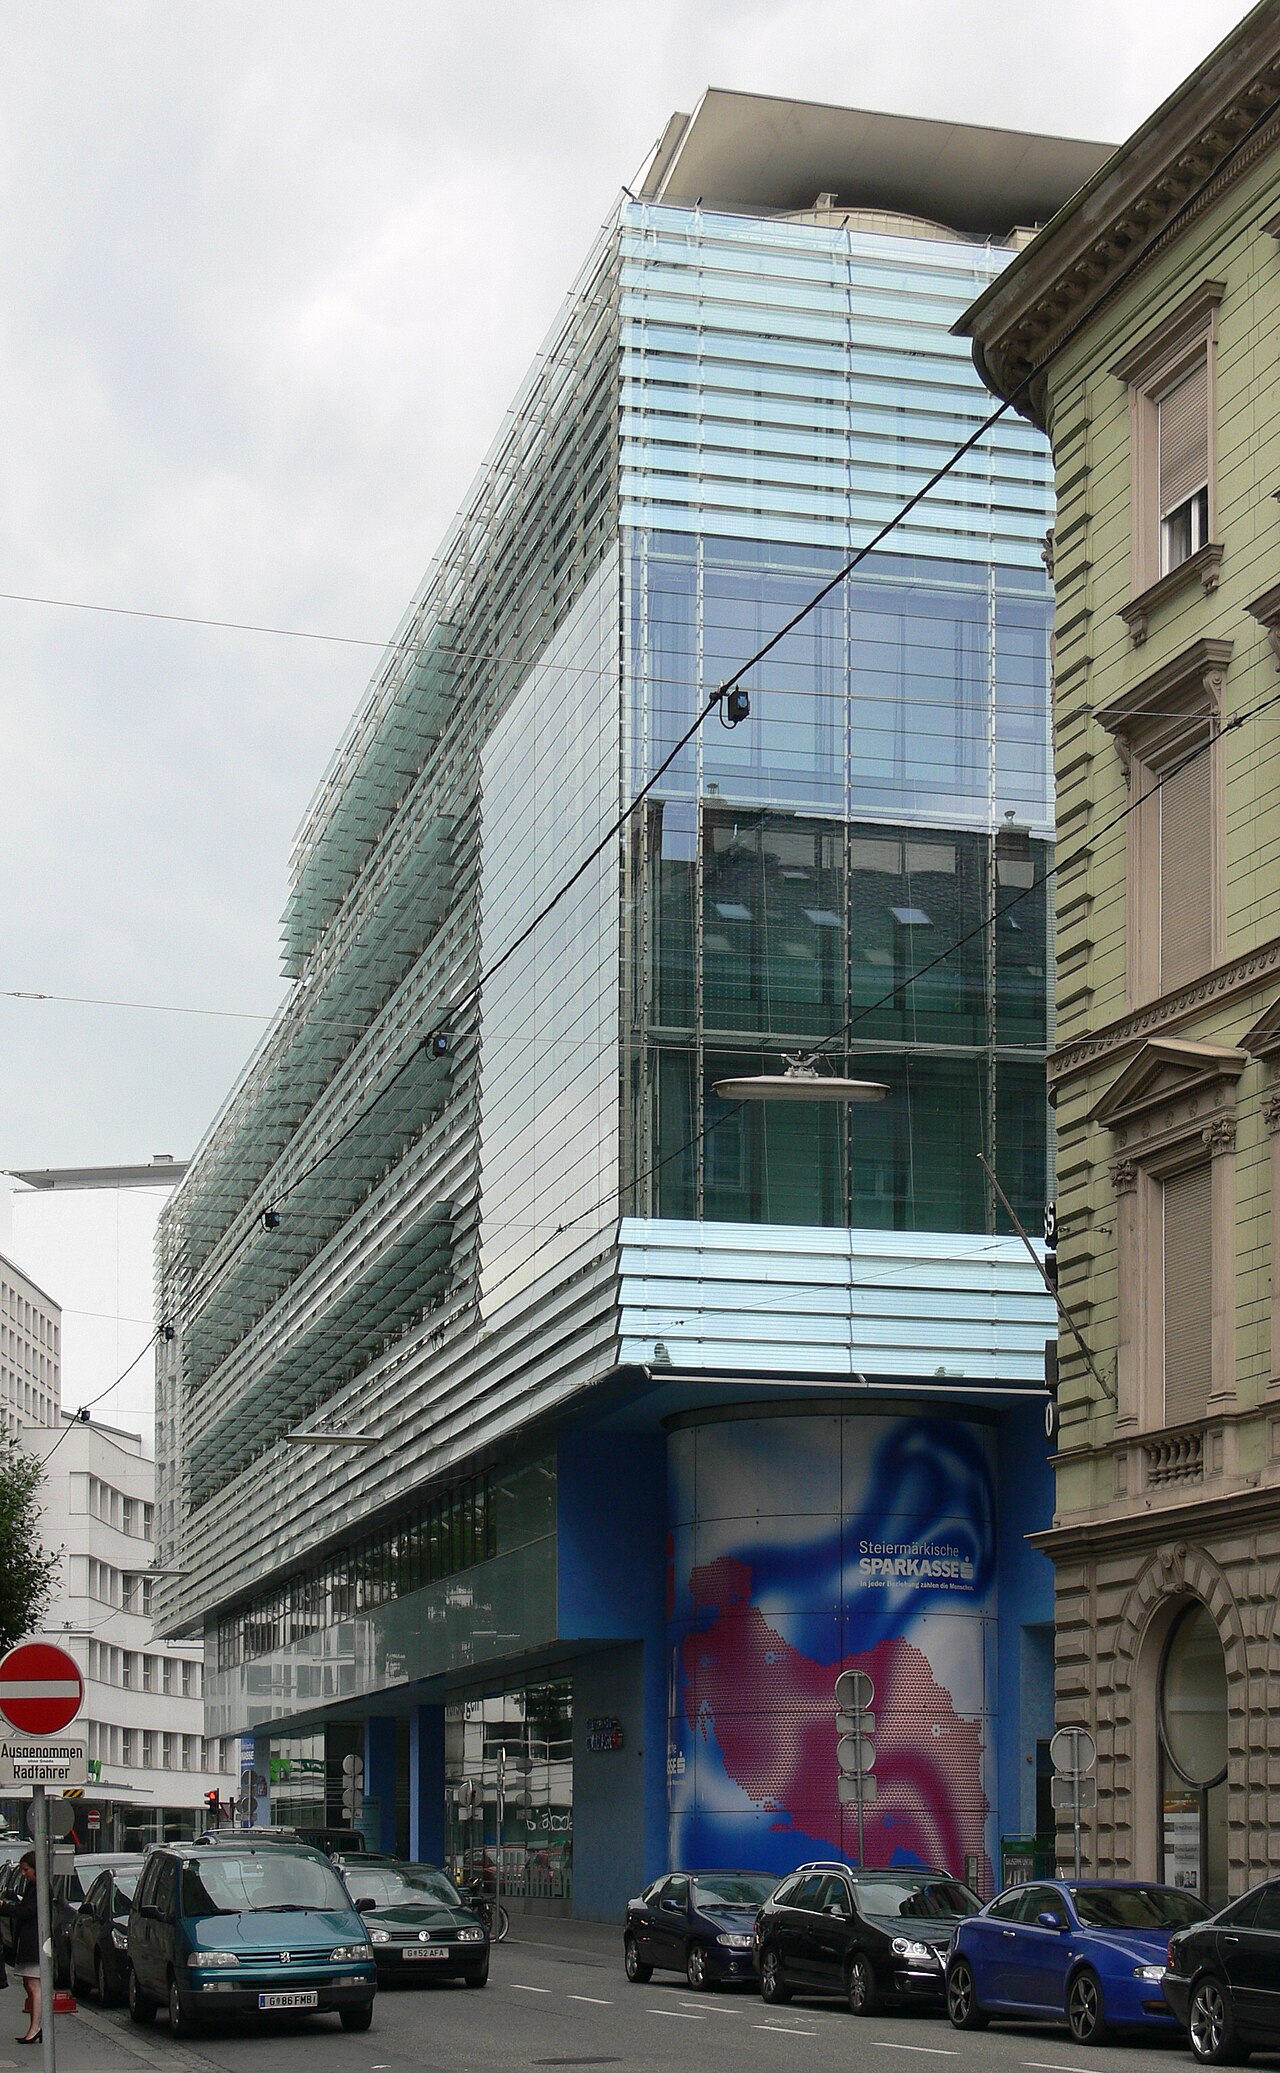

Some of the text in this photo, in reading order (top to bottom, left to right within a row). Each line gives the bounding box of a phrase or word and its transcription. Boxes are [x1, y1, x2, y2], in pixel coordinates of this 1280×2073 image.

[859, 1540, 960, 1557] Steiermärkische
[859, 1557, 960, 1579] SPARKASSE
[868, 1580, 886, 1588] jeder
[1, 1743, 83, 1758] Ausgenommen
[13, 1765, 70, 1779] Radfahrer
